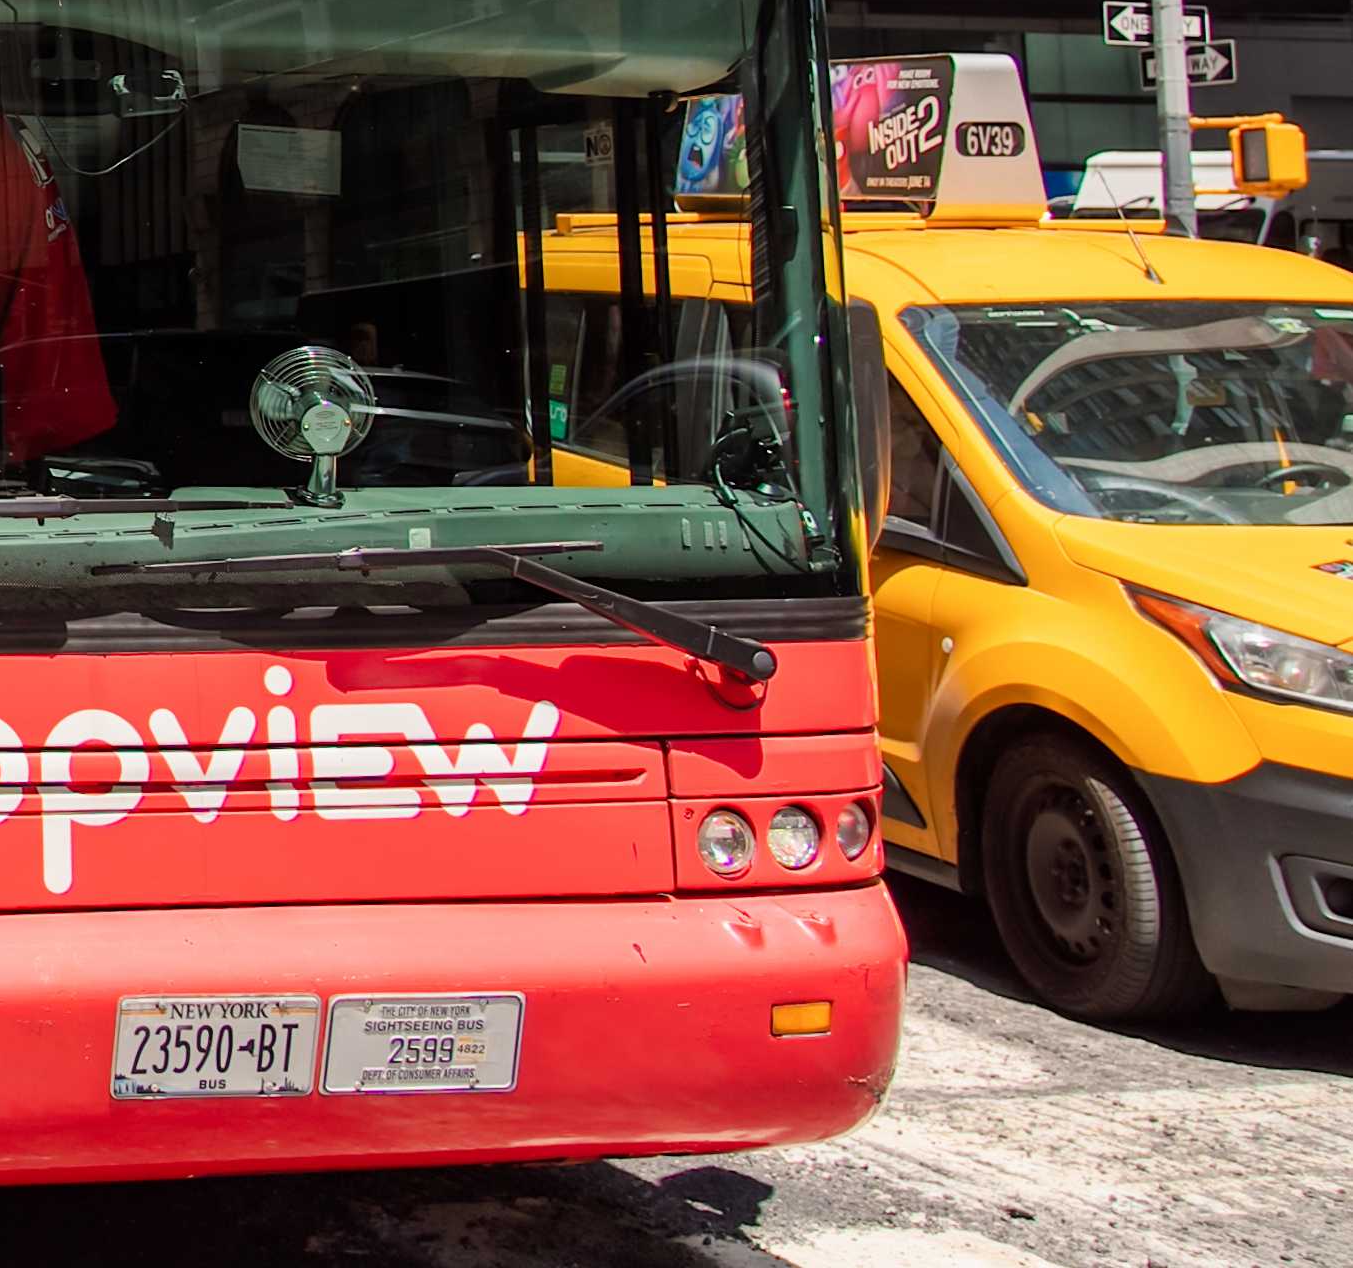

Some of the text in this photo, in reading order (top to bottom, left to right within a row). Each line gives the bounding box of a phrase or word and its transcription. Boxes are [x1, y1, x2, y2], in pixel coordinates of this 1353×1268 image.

[1121, 15, 1149, 31] ONE
[1191, 54, 1219, 72] WAY
[868, 105, 920, 154] INSIDE
[917, 95, 943, 154] 2
[966, 125, 1014, 156] 6V39
[885, 131, 919, 170] OUT
[169, 1003, 270, 1020] NEW YORK
[381, 1005, 470, 1017] THE CITY OF NEW YORK
[364, 1019, 484, 1032] SIGHTSEEING BUS
[388, 1036, 486, 1064] 2599 4822
[386, 1069, 396, 1079] OF
[397, 1068, 442, 1079] CONSUMER
[198, 1079, 227, 1091] BUS
